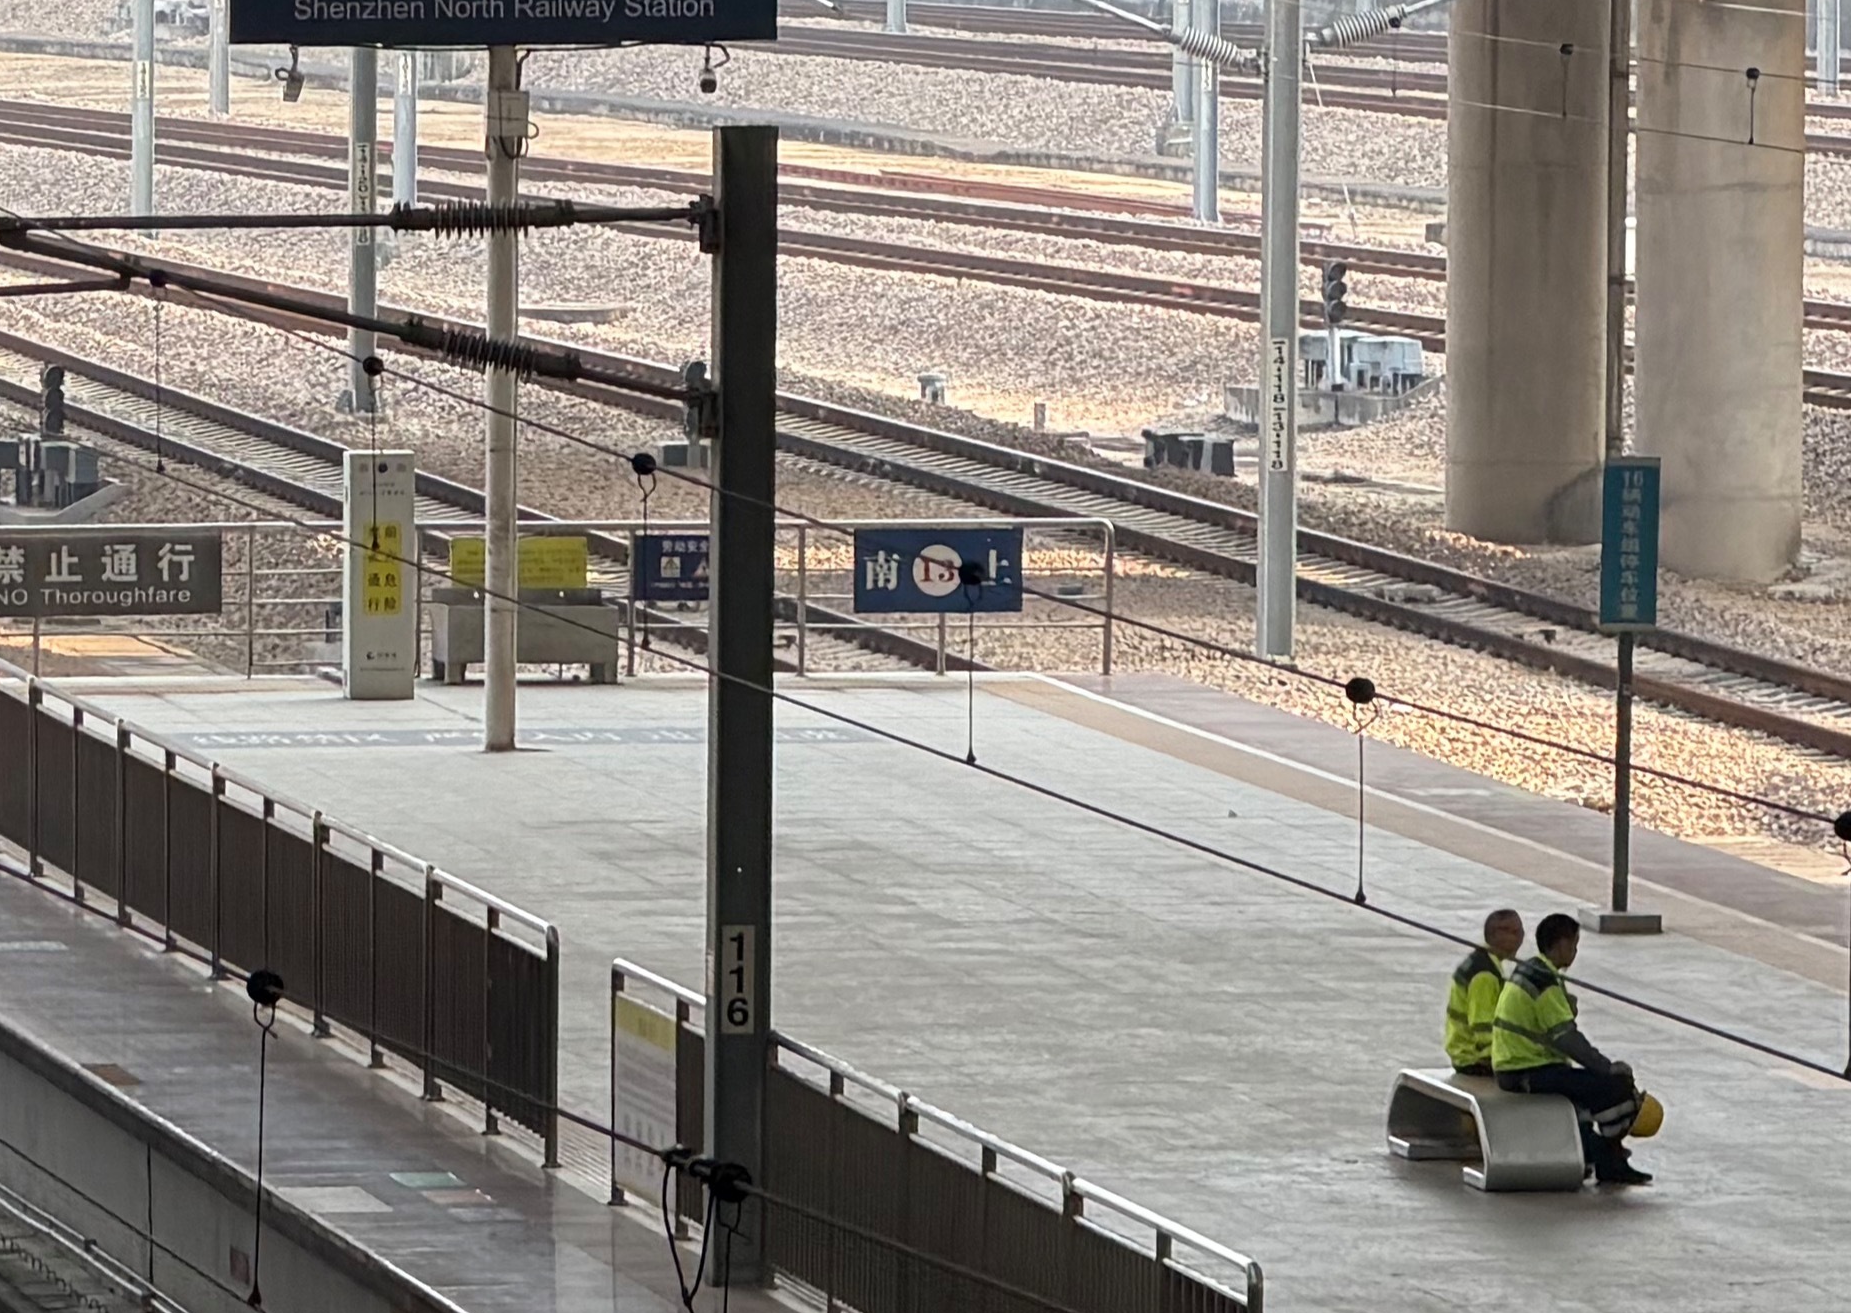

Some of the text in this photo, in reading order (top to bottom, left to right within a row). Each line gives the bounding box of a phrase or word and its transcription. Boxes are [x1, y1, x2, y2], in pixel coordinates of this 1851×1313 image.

[863, 550, 902, 591] 南
[39, 586, 192, 609] Thoroughfare
[727, 931, 750, 1027] 116
